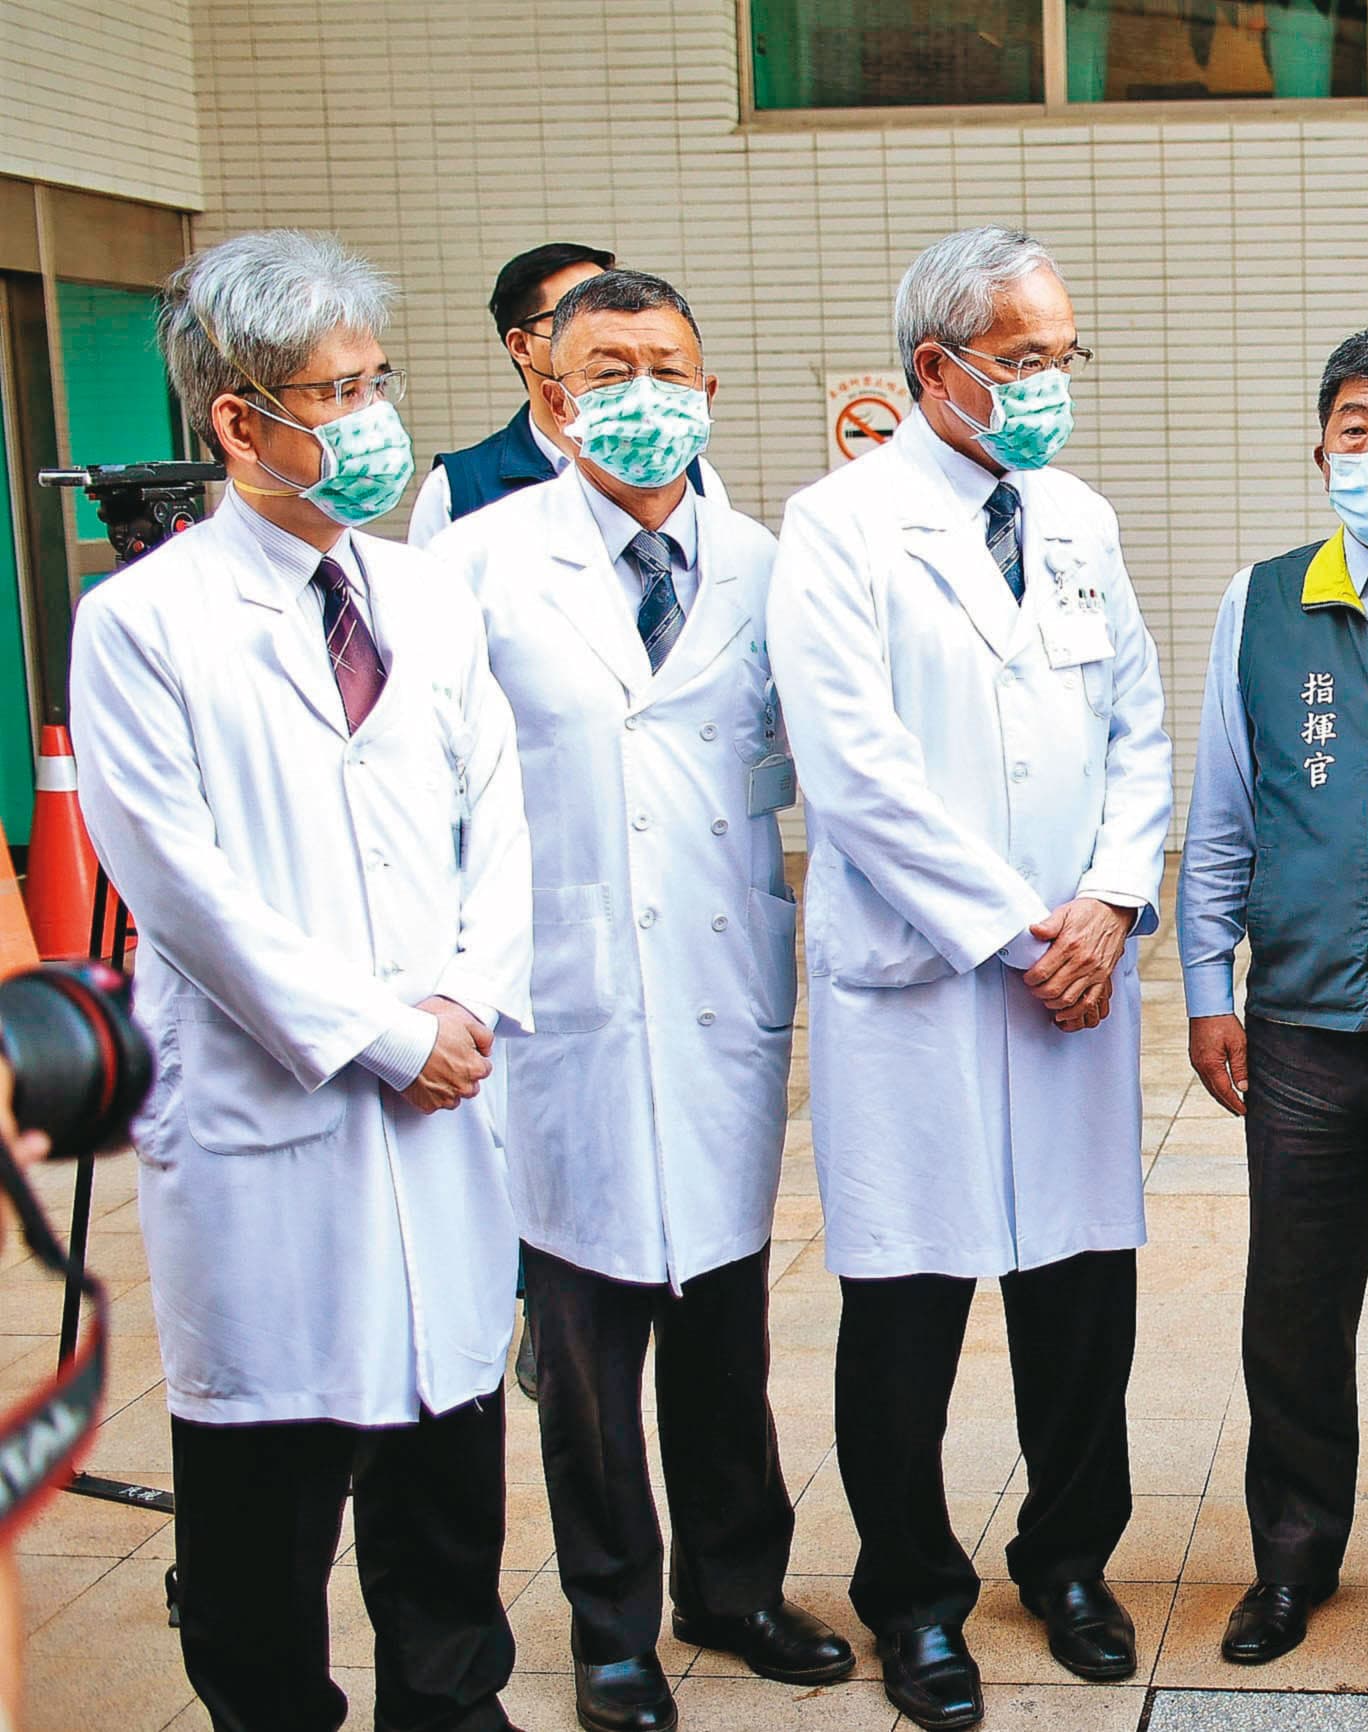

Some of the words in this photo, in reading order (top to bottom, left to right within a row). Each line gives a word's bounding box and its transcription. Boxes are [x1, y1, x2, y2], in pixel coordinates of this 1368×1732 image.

[1301, 672, 1337, 788] 指揮官
[0, 1396, 88, 1512] TAL
